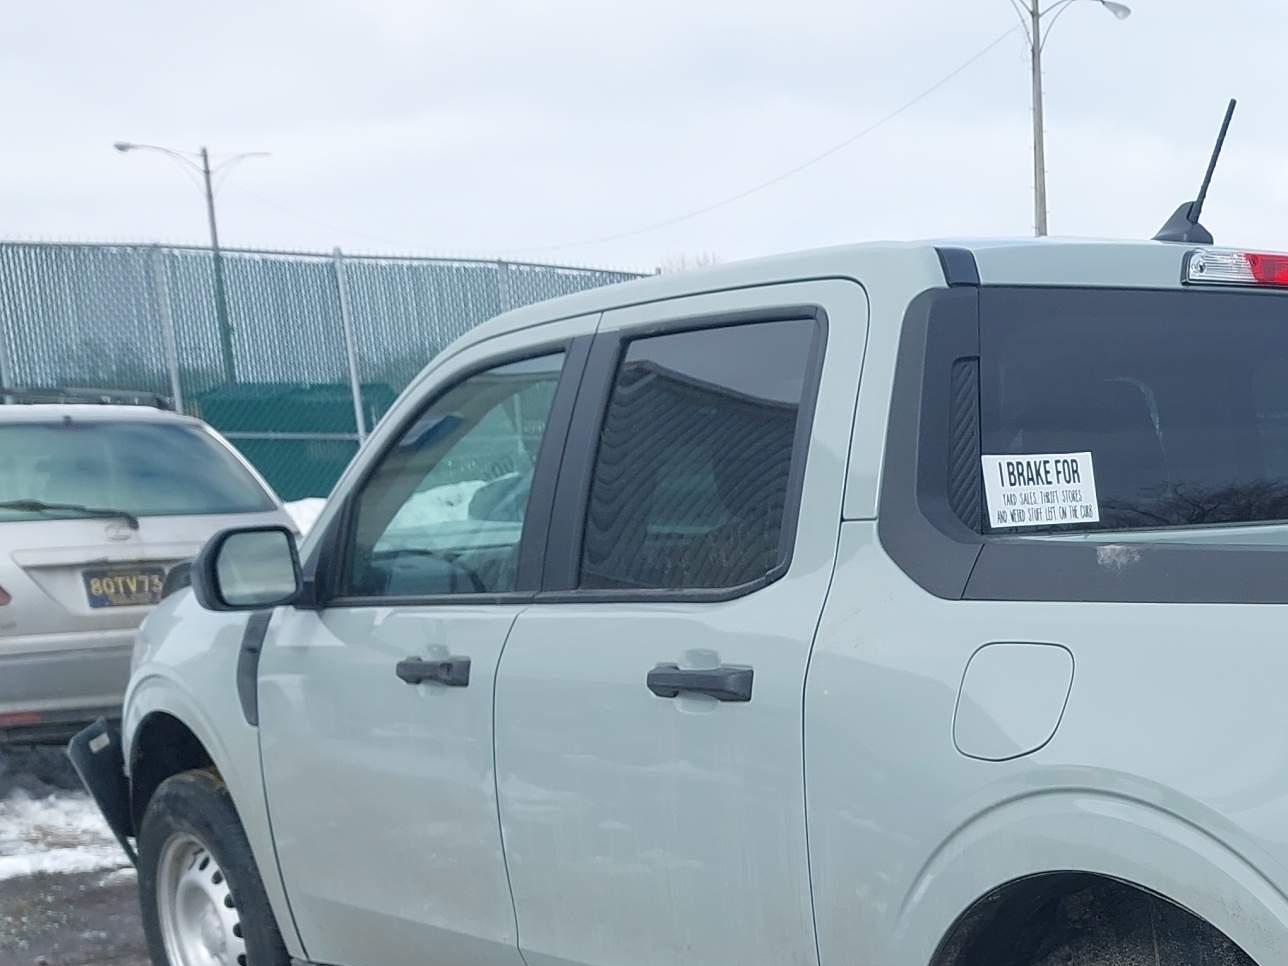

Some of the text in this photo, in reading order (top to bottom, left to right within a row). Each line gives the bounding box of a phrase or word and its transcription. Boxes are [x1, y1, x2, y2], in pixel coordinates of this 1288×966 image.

[998, 458, 1081, 487] I BRAKE FOR
[997, 504, 1094, 524] AND WEIRD STUFF LEFT ON THE CURB
